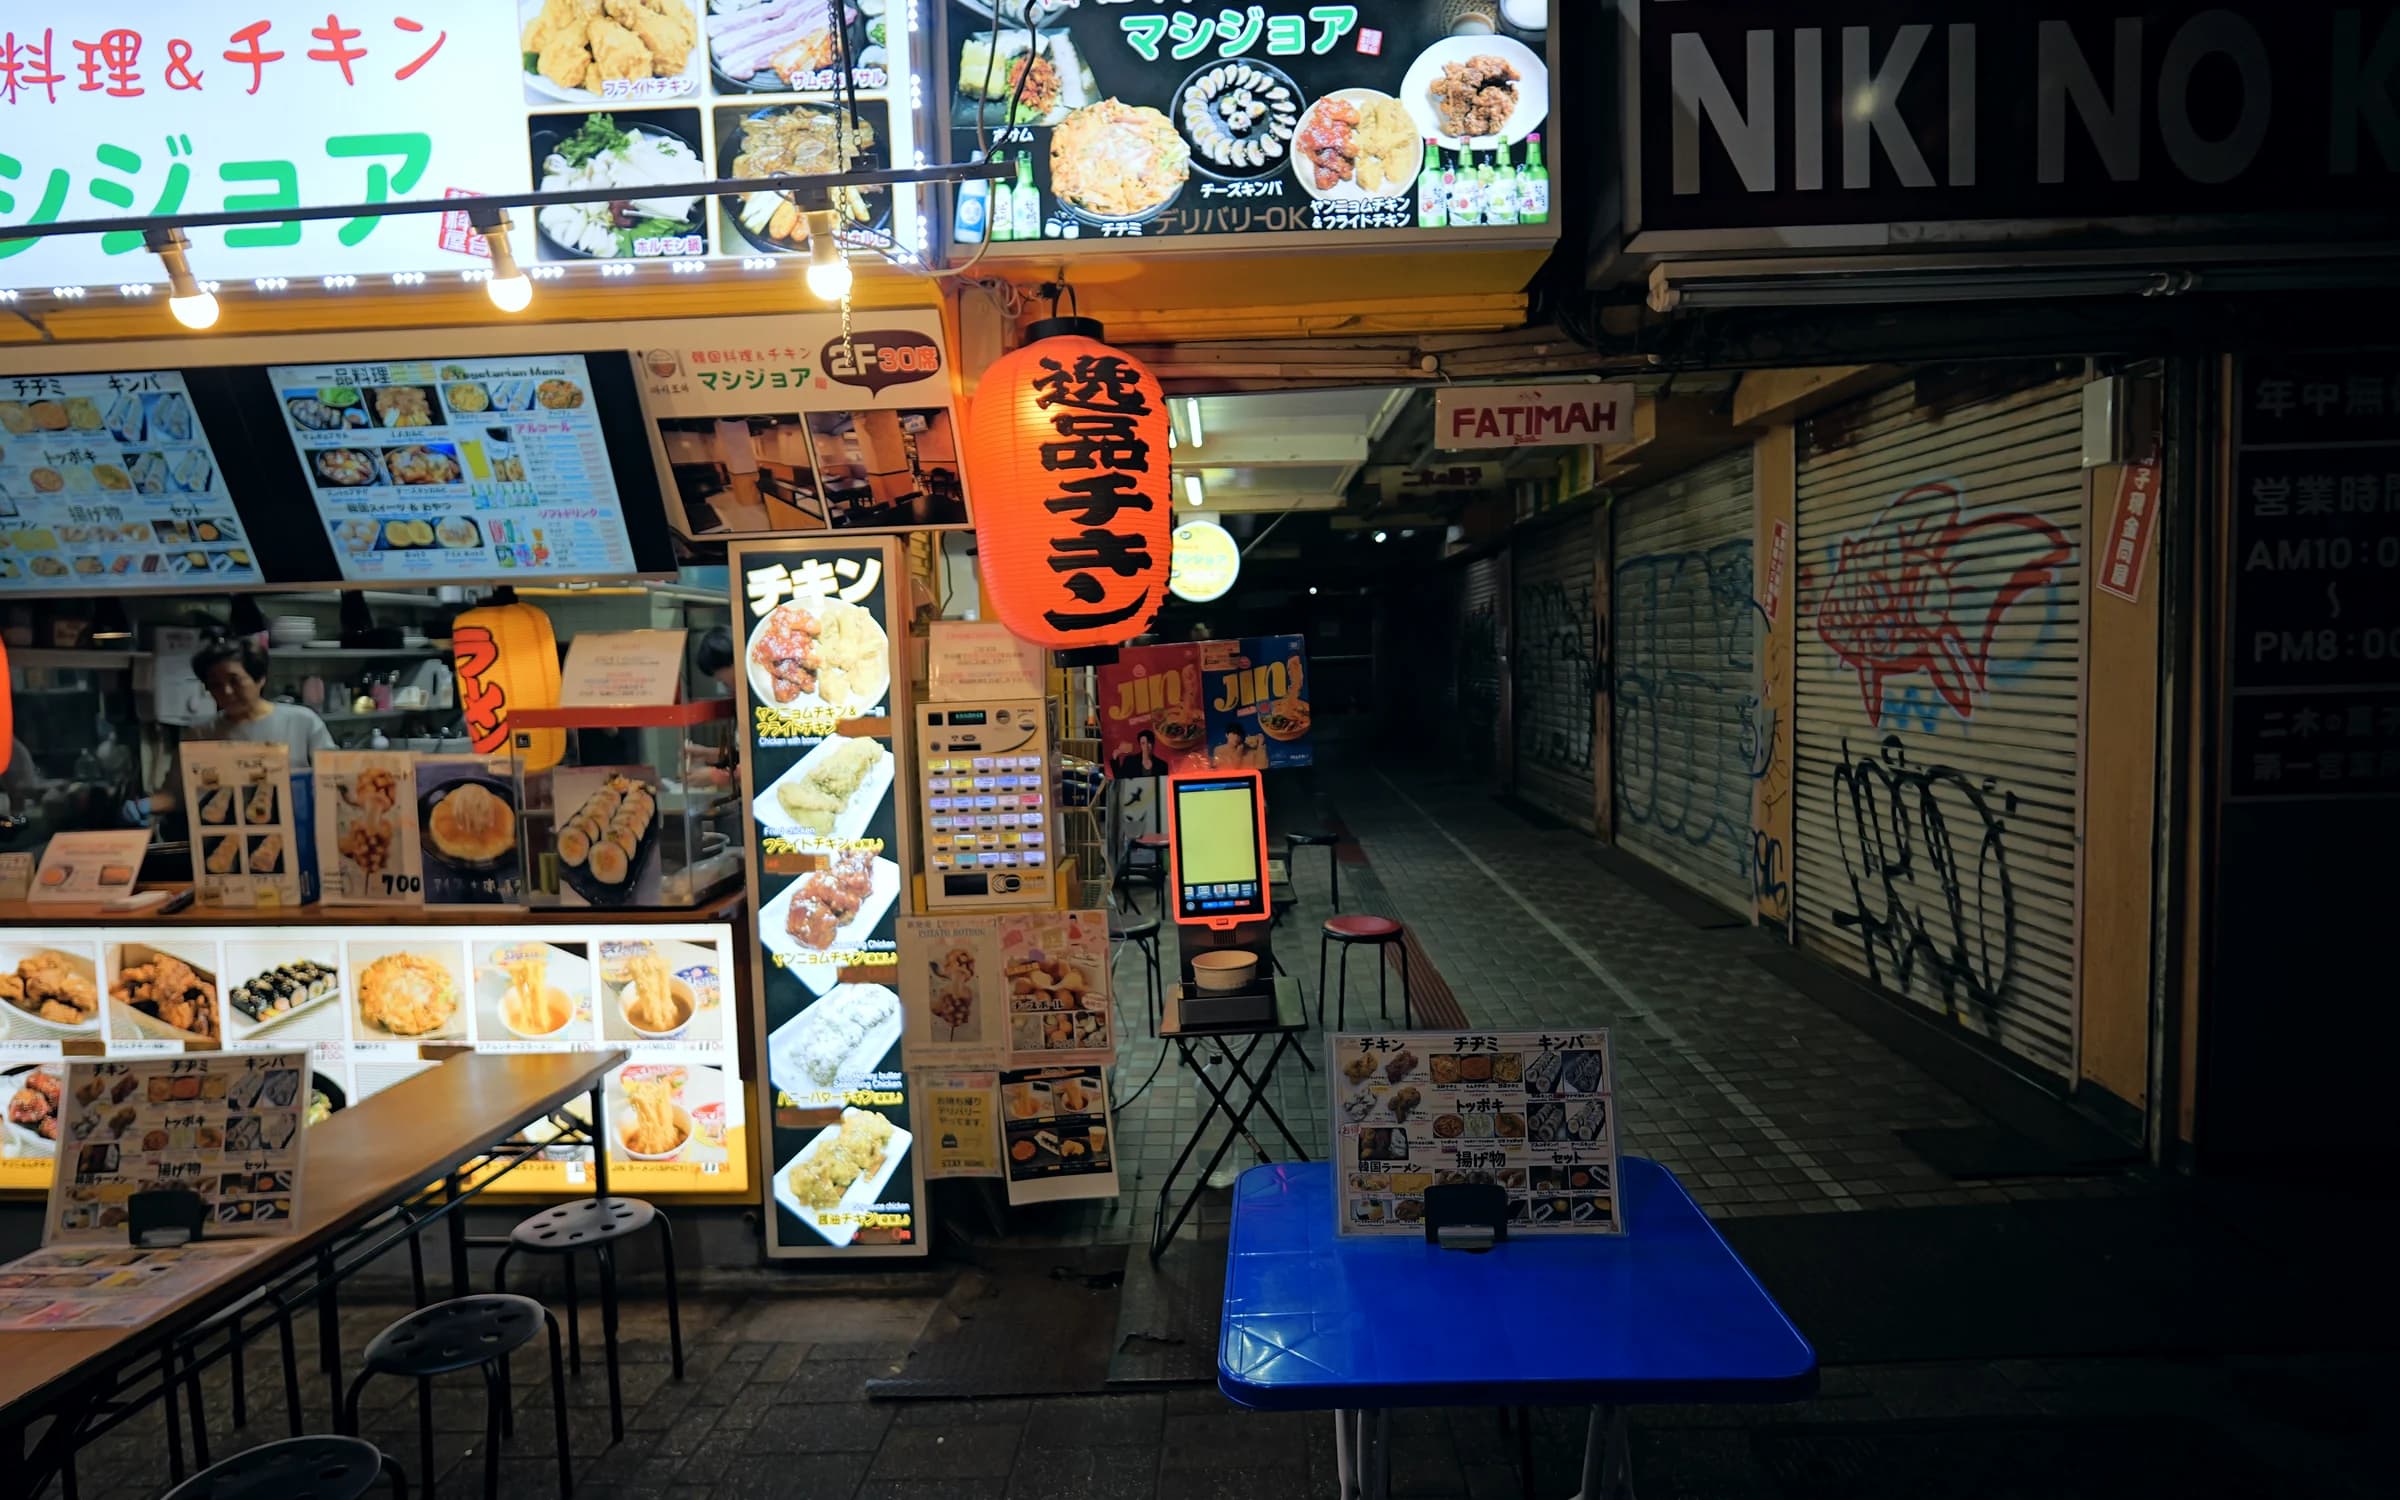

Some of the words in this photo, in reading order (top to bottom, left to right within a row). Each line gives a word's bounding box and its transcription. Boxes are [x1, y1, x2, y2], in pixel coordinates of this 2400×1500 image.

[1120, 5, 1357, 62] マシジョア
[603, 78, 695, 97] フライドチキン
[1670, 24, 1976, 195] NIKI
[2037, 9, 2272, 184] NO
[1310, 197, 1411, 214] ヤンニョムチキン
[316, 366, 391, 385] 一品料理
[529, 366, 565, 376] Menu
[697, 368, 811, 391] マシジョア
[515, 421, 571, 433] アルコール
[1453, 401, 1617, 438] FATIMAH
[746, 558, 882, 617] チキン
[757, 720, 837, 737] フライドチキン
[759, 737, 786, 747] Chicken
[788, 737, 801, 746] with
[382, 874, 420, 895] 700
[868, 940, 897, 949] Chicken
[1360, 1037, 1405, 1052] チキン
[1454, 1036, 1499, 1052] チヂミ
[1539, 1035, 1585, 1051] キンパ
[93, 1064, 130, 1076] チキン
[171, 1060, 208, 1073] チヂミ
[872, 1080, 902, 1088] Chicken
[1457, 1098, 1505, 1113] トッポキ
[1359, 1161, 1422, 1173] 韓国ラーメン
[1456, 1151, 1506, 1168] 揚げ物
[1552, 1153, 1582, 1165] セット
